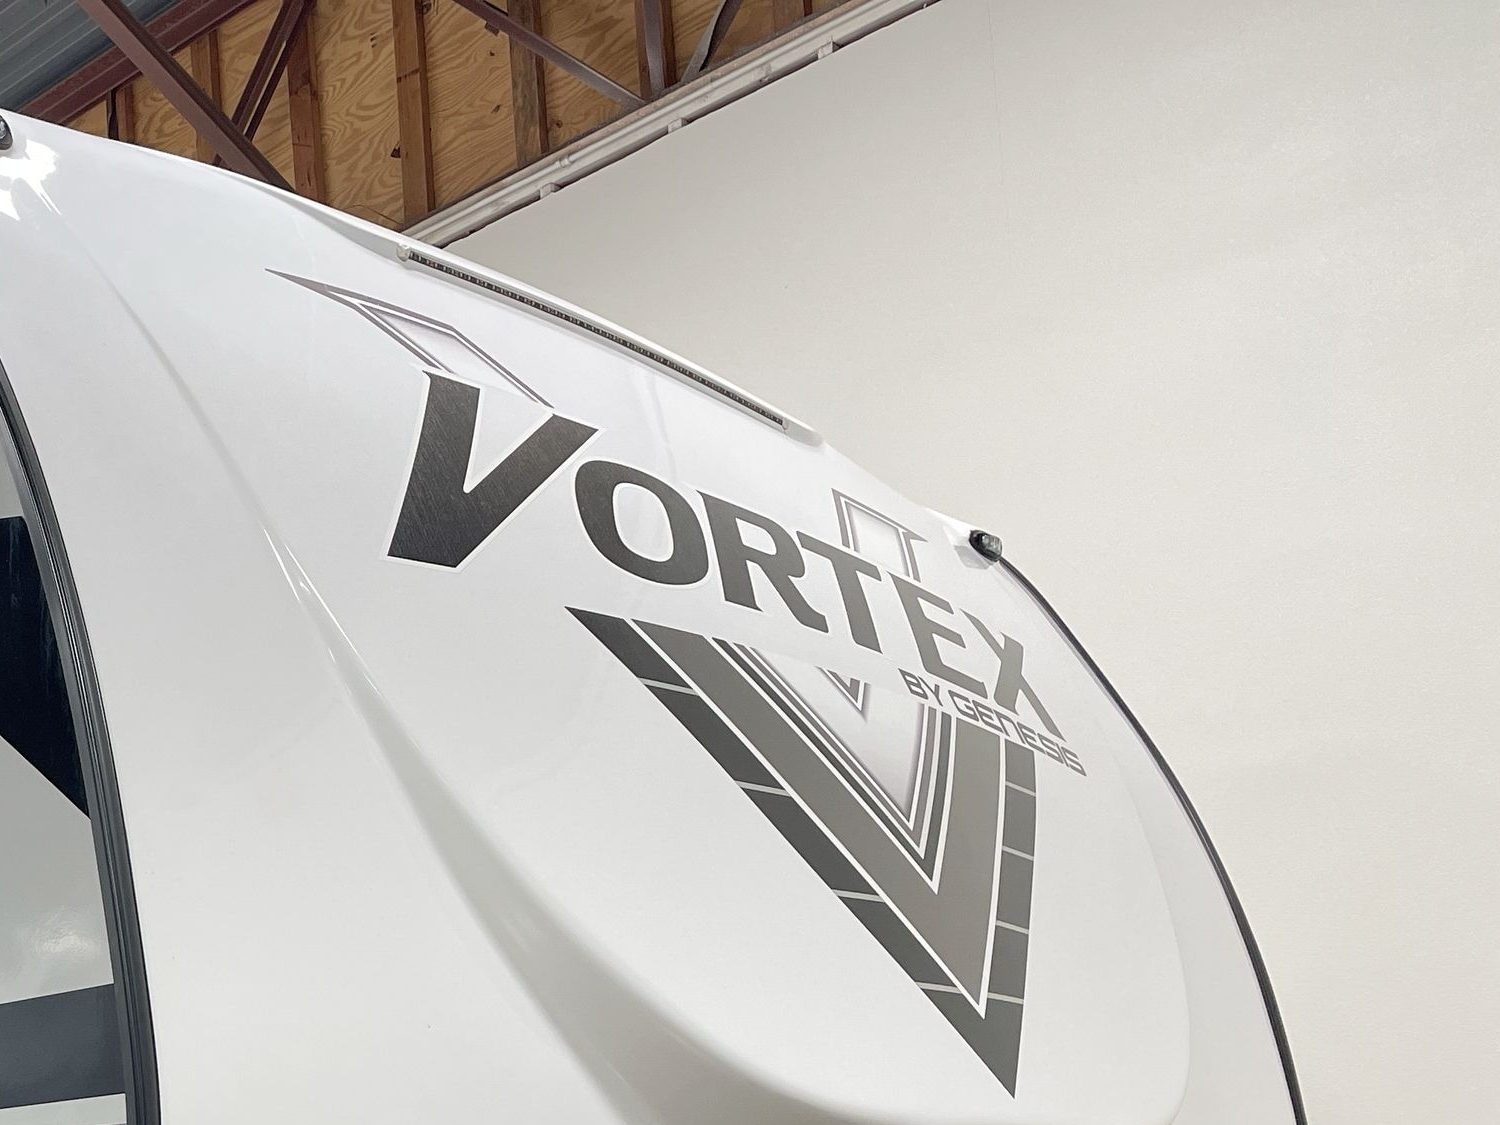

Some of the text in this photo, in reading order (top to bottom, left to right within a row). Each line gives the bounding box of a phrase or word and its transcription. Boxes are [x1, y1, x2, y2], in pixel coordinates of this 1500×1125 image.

[386, 370, 1067, 741] VORTEX
[898, 667, 1088, 777] BY GENESIS
